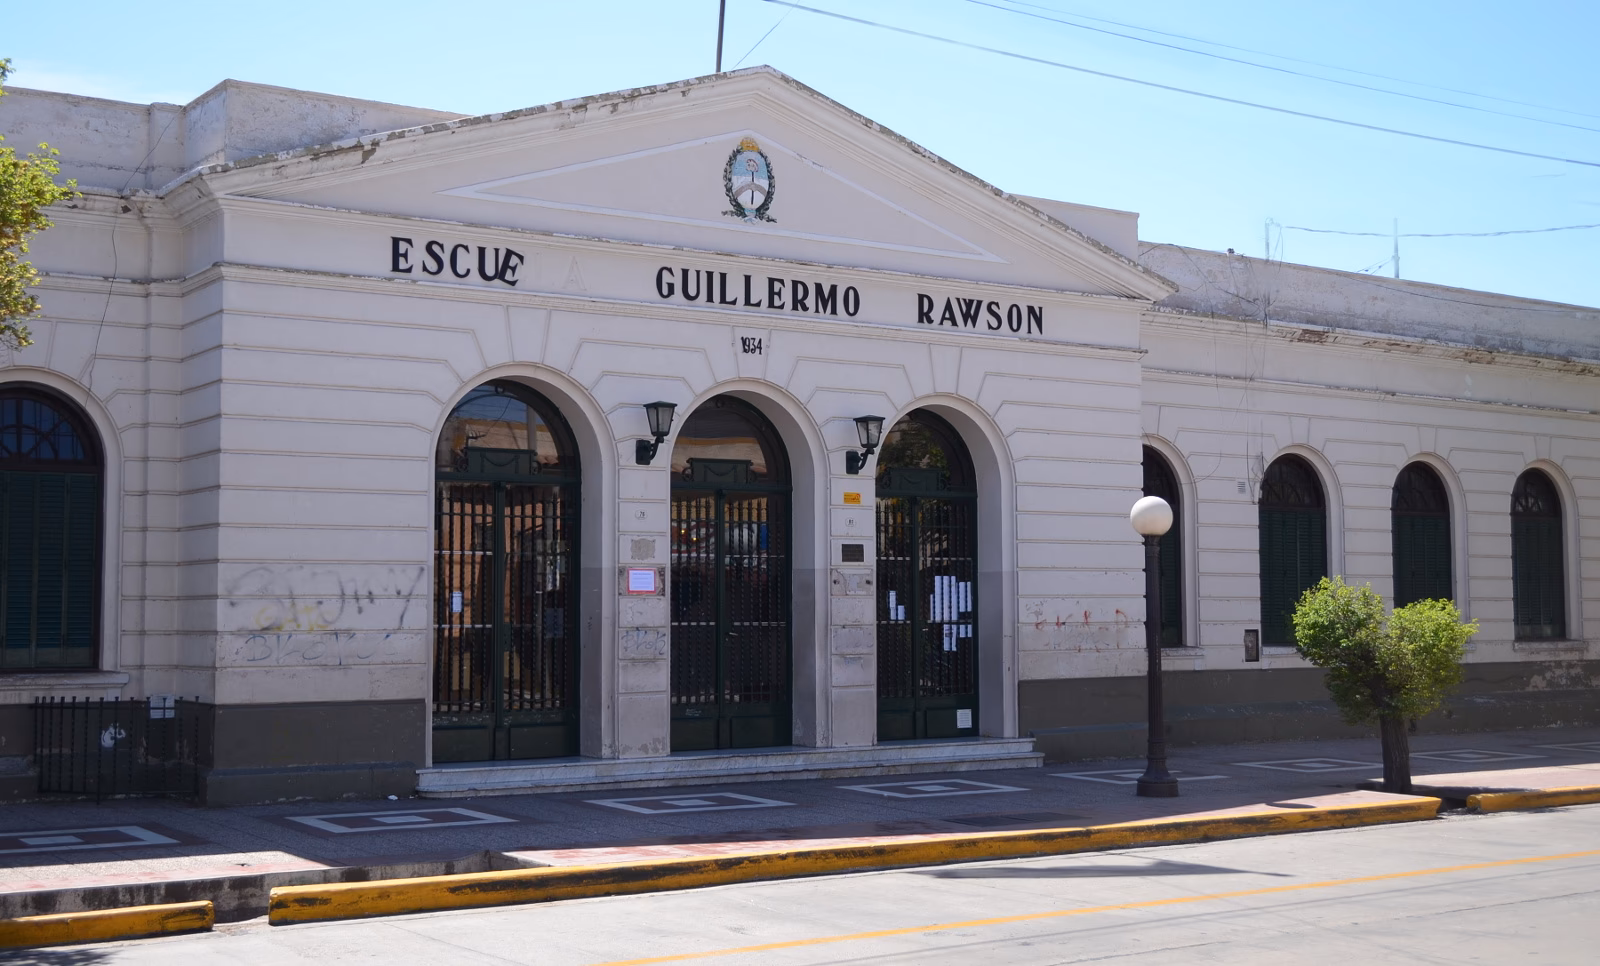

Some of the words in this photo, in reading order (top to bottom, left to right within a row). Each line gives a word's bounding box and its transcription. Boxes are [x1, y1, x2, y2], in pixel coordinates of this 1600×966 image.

[655, 266, 861, 317] GUILLERMO
[917, 293, 1043, 335] RAWSON
[740, 336, 763, 355] 1934
